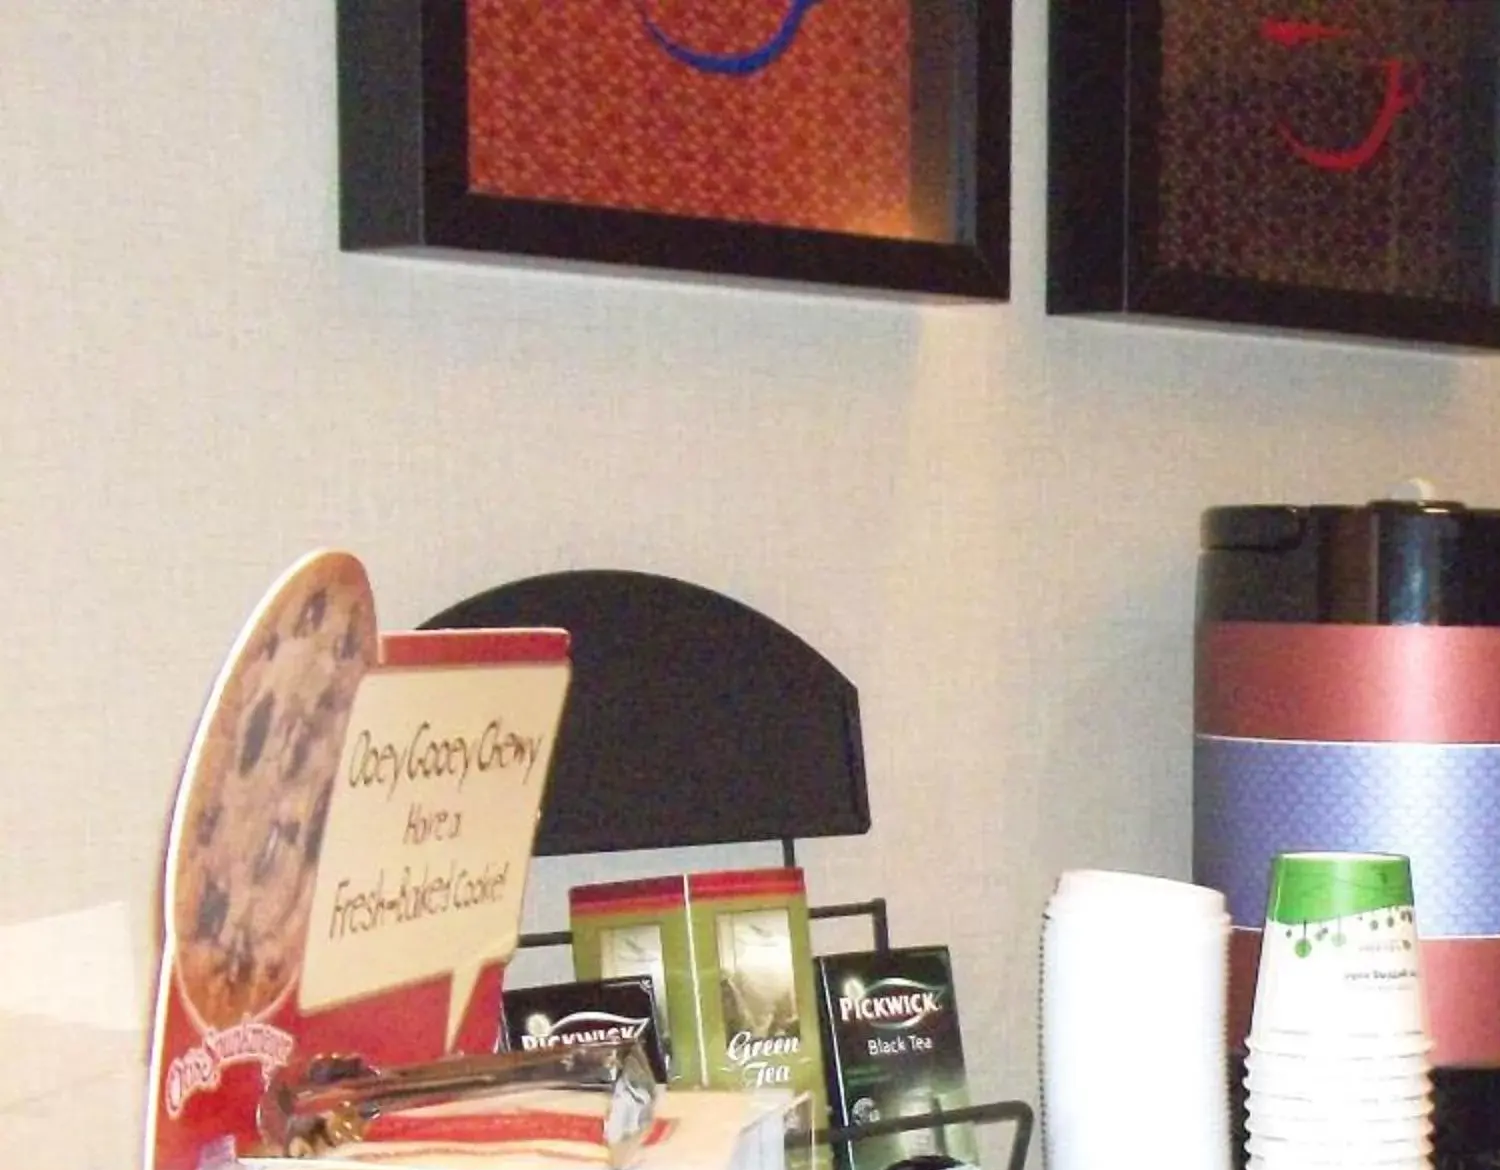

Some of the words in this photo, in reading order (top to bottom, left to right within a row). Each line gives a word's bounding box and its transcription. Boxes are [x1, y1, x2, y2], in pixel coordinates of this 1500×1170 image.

[349, 729, 400, 801] Ooey
[405, 720, 474, 794] Gooey
[838, 990, 941, 1023] PICKWICK
[725, 1030, 801, 1066] Green
[867, 1036, 905, 1056] Black
[907, 1033, 934, 1050] Tea
[743, 1061, 791, 1089] Tea
